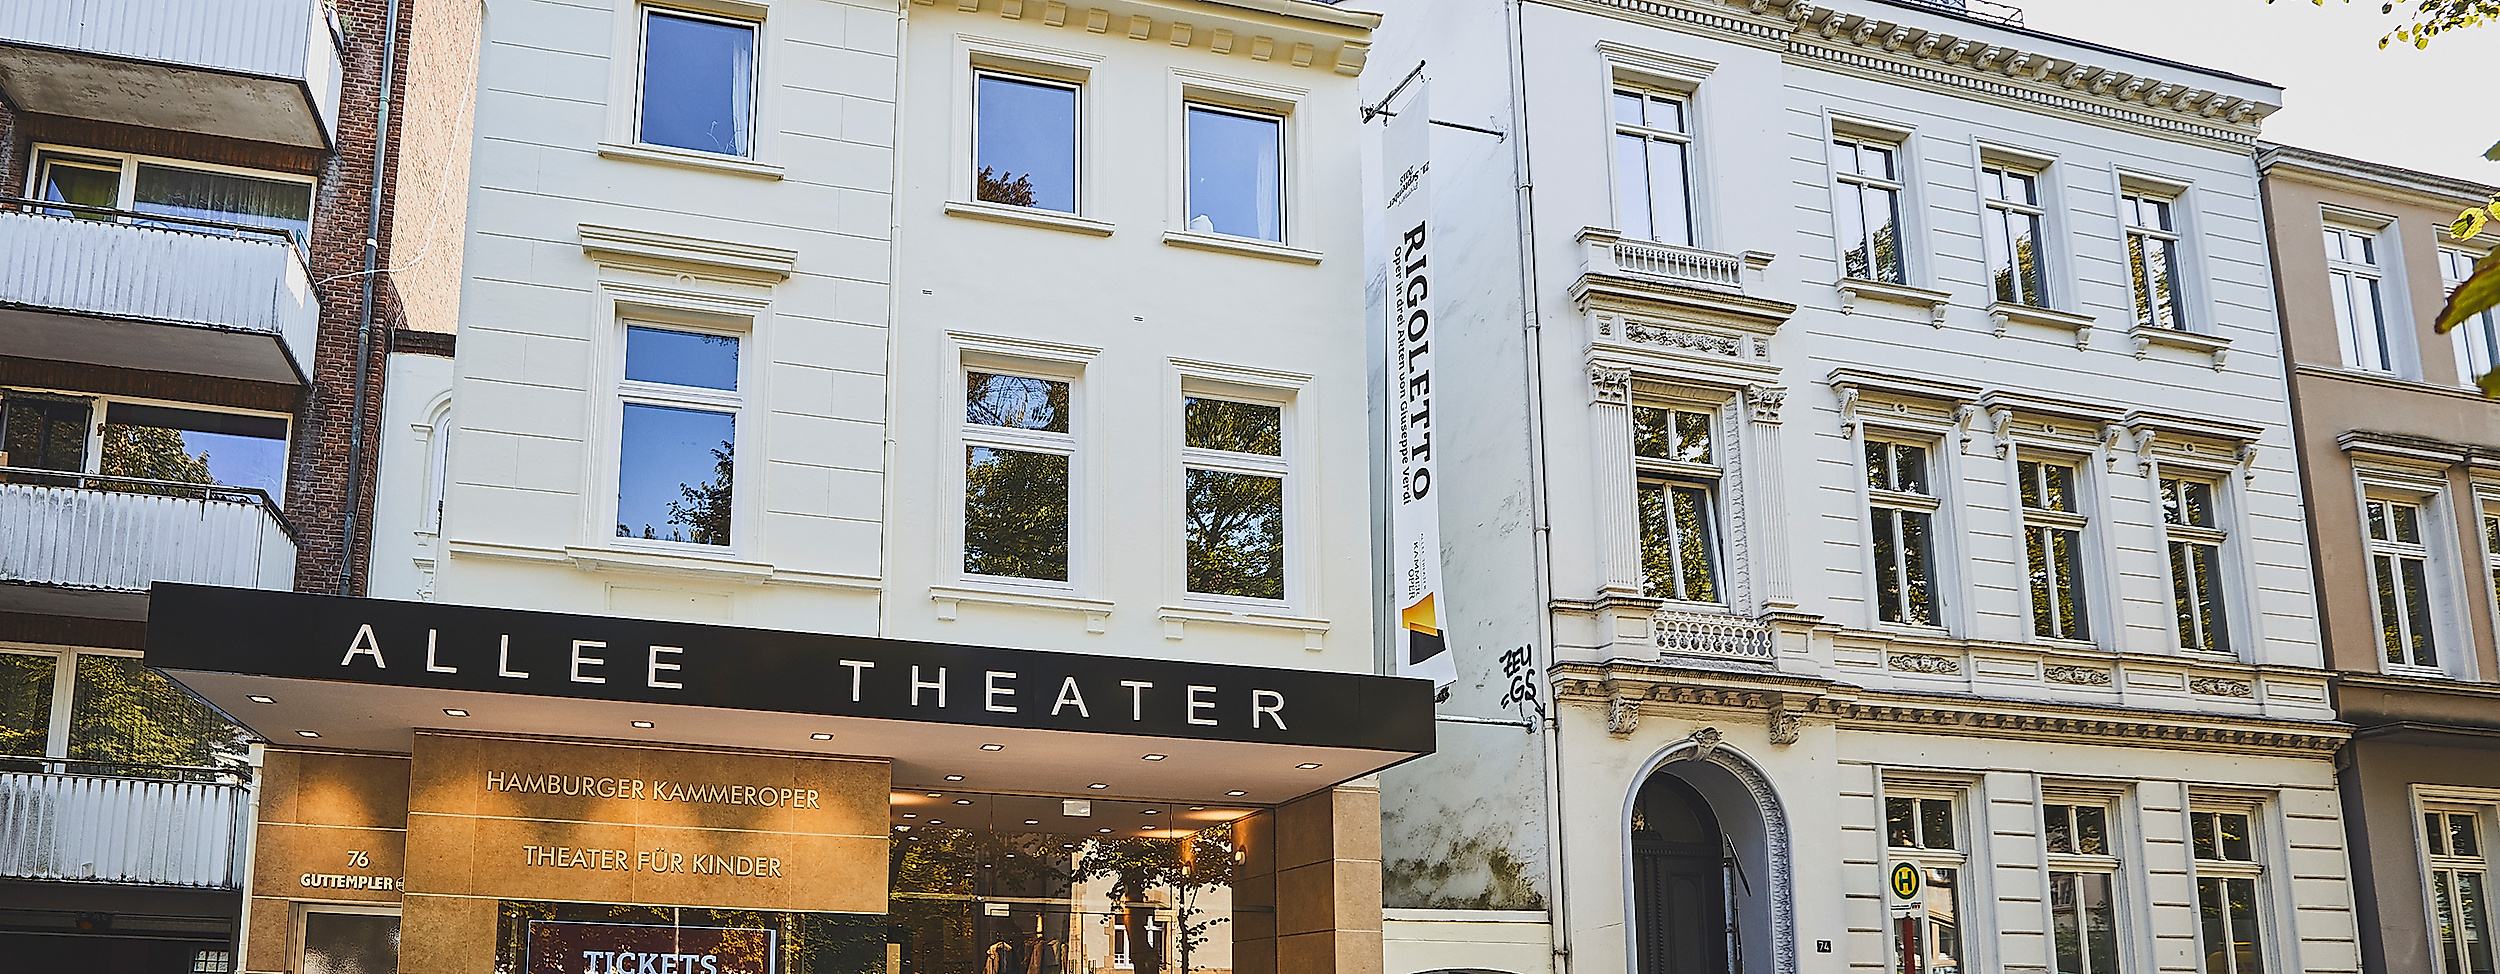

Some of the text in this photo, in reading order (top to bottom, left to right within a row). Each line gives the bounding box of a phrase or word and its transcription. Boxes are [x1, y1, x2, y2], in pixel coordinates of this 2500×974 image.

[1386, 170, 1419, 209] September
[1393, 245, 1412, 506] Oper in drei Akten von Giuseppe Verdi
[1404, 220, 1431, 501] RIGOLETTO
[1408, 569, 1416, 600] OPER
[1413, 541, 1421, 596] KAMMER
[340, 622, 1288, 730] ALLEE THEATER
[485, 770, 820, 809] HAMBURGER KAMMEROPER
[347, 849, 370, 868] 76
[523, 845, 782, 878] THEATER FÜR KINDER
[300, 873, 393, 892] GUTTEMPLER
[1898, 870, 1912, 891] H
[583, 951, 718, 974] TICKETS
[1818, 941, 1830, 951] 74
